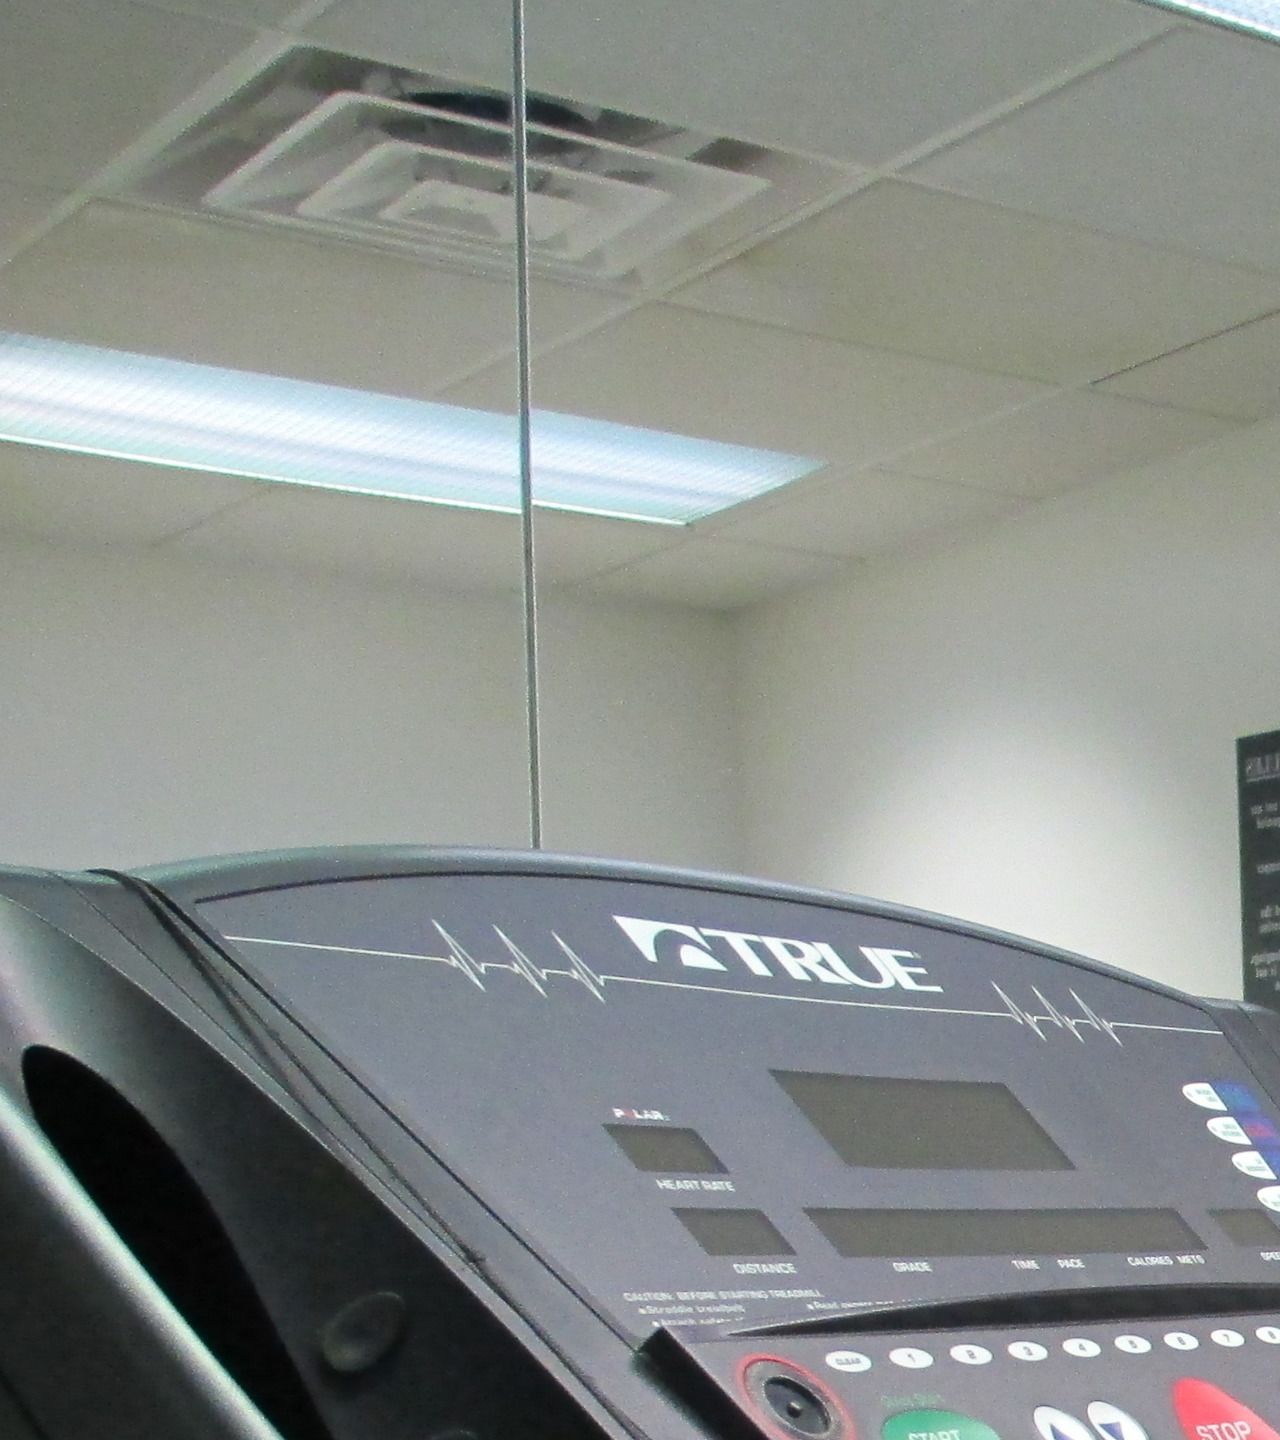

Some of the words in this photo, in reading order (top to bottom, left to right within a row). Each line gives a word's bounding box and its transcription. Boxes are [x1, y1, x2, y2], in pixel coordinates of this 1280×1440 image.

[698, 927, 944, 993] TRUE
[656, 1180, 701, 1191] HEART
[701, 1181, 736, 1192] RATE
[1011, 1260, 1040, 1270] TIME
[1057, 1259, 1085, 1268] PACE
[1127, 1256, 1173, 1266] CALORIES
[732, 1263, 797, 1274] DISTANCE
[893, 1262, 932, 1272] GRADE
